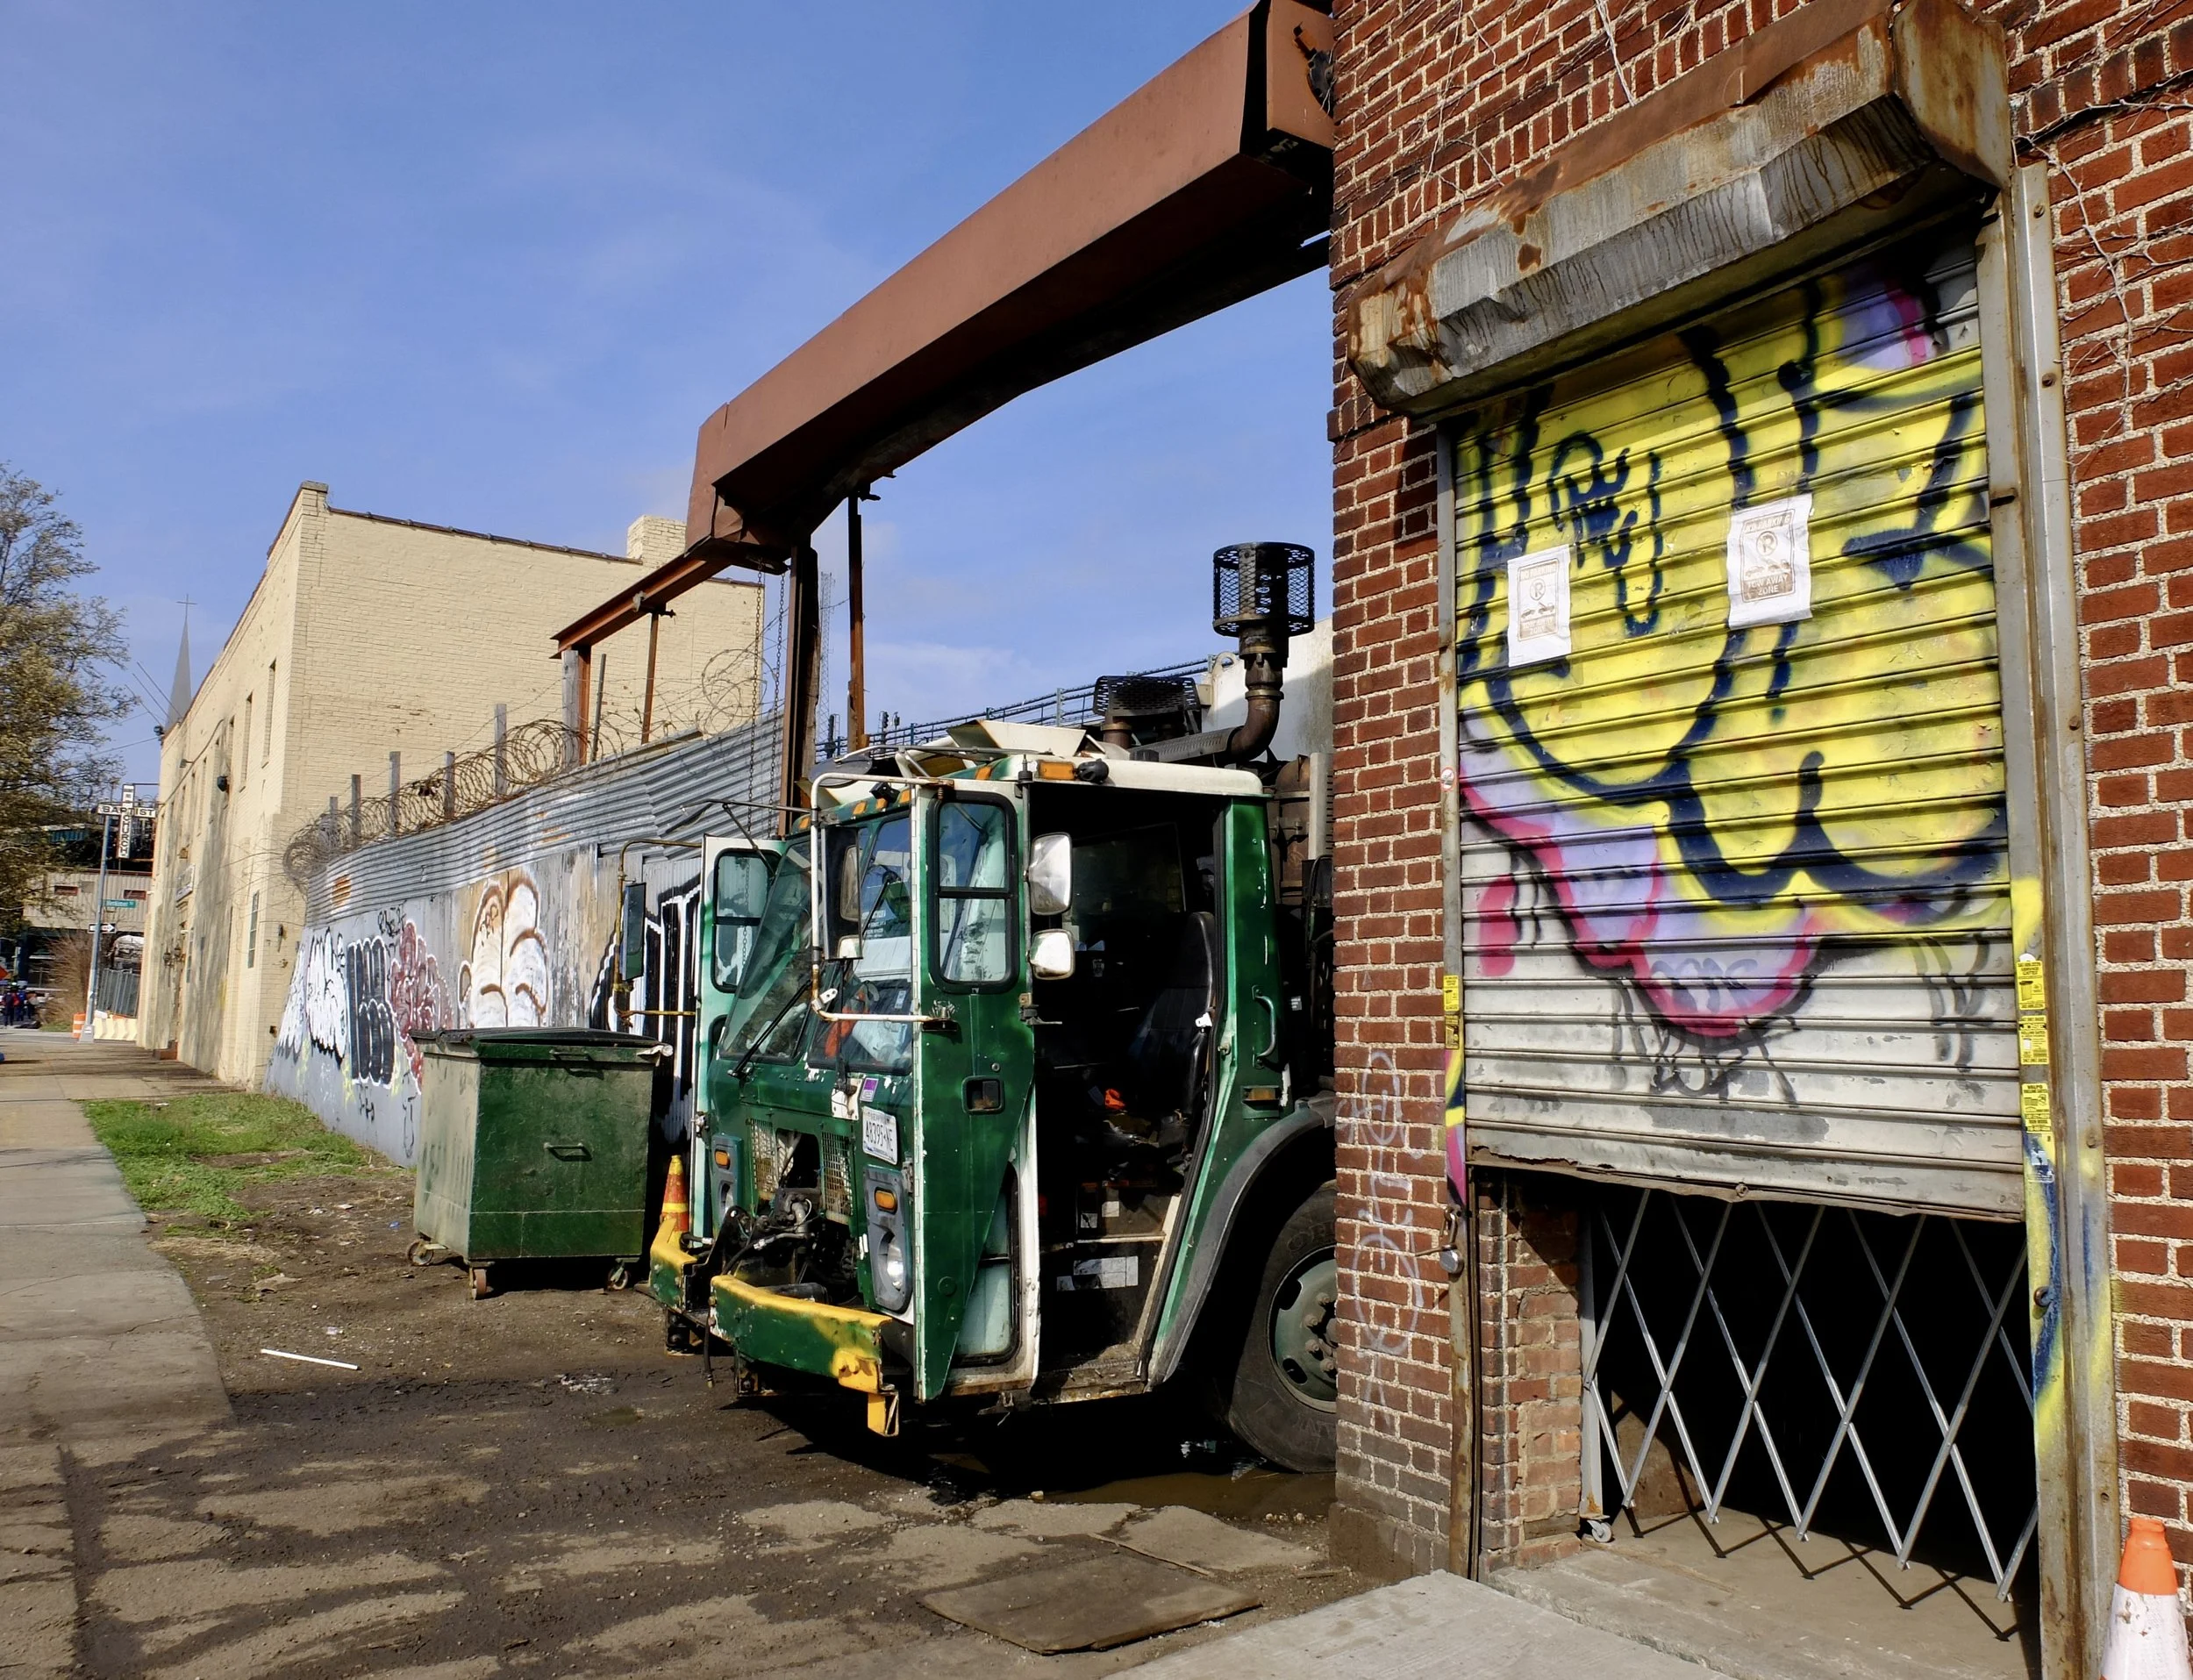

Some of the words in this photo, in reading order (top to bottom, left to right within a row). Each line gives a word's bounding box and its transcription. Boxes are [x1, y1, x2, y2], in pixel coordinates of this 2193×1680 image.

[1758, 513, 1791, 528] PARKIG
[1765, 574, 1789, 587] AWAY
[1758, 585, 1779, 596] ZONE
[103, 805, 154, 817] BAPTIST
[120, 814, 131, 854] CHURCH
